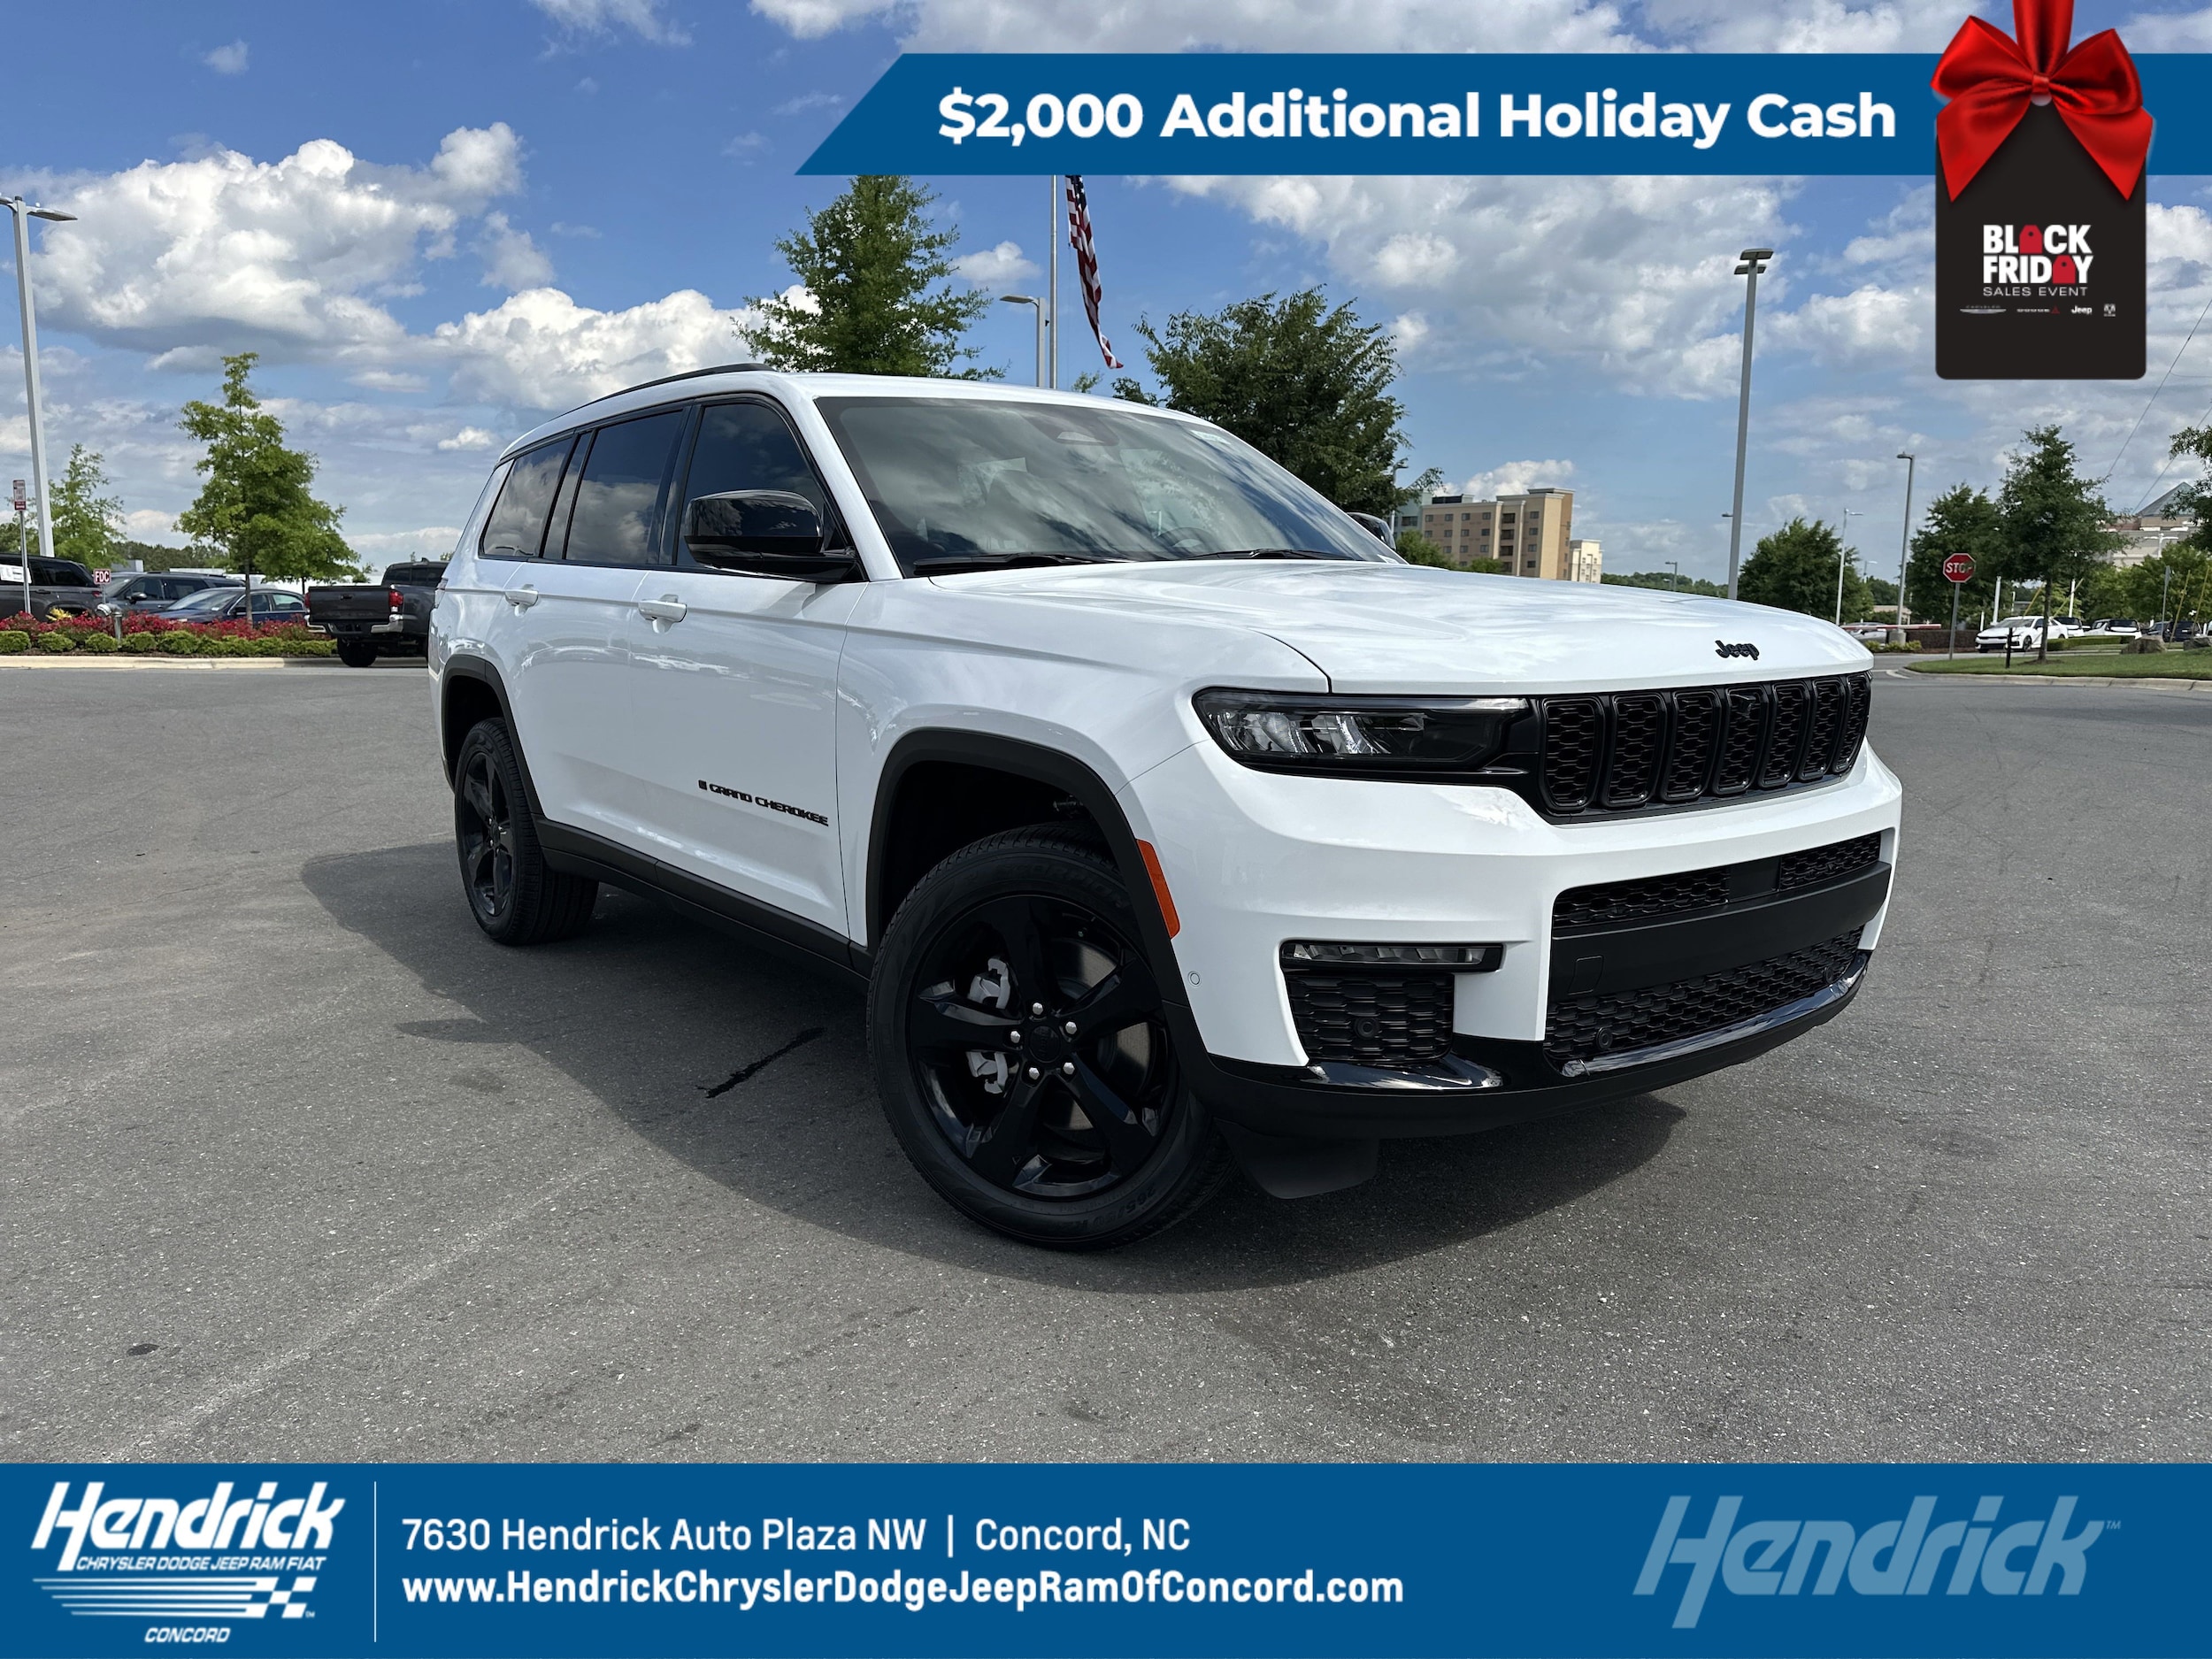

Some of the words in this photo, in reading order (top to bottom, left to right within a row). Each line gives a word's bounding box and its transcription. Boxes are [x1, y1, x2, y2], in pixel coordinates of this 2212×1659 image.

[1946, 562, 1972, 573] STO
[95, 571, 110, 583] FDC
[1715, 640, 1760, 661] Jeep
[710, 783, 752, 803] GRAND
[756, 796, 829, 826] CHEROKEE
